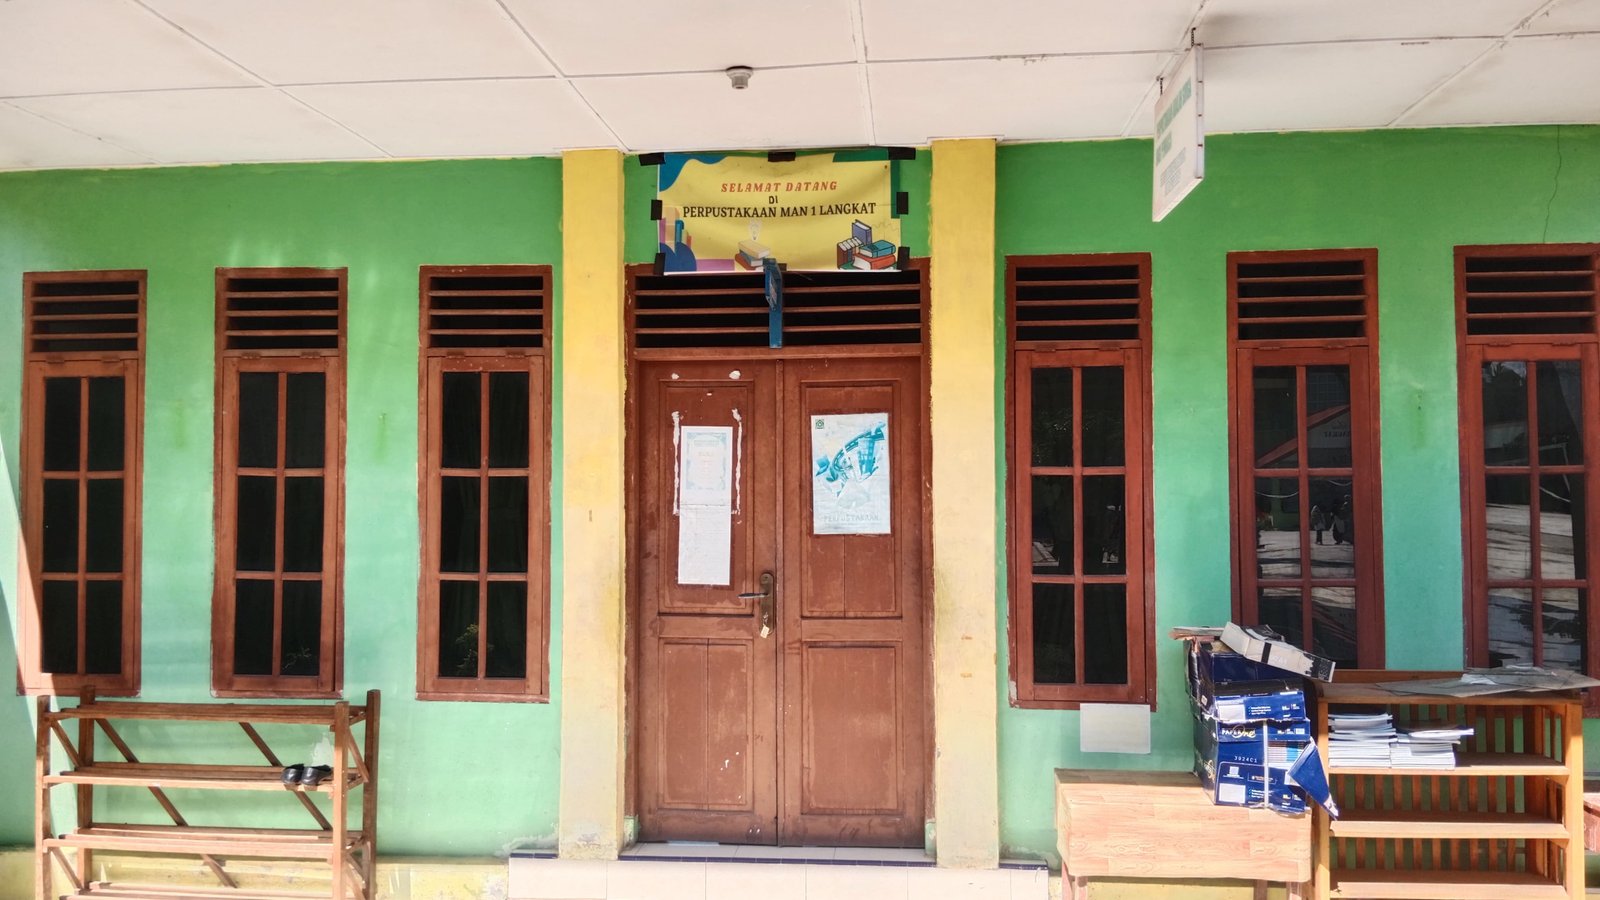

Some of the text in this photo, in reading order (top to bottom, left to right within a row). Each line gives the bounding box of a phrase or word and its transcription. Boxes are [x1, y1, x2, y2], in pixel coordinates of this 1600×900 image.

[721, 181, 838, 193] SELAMAT DATANG
[768, 195, 779, 205] DI
[682, 202, 877, 218] PERPUSTAKAAN MAN 1 LANGKAT
